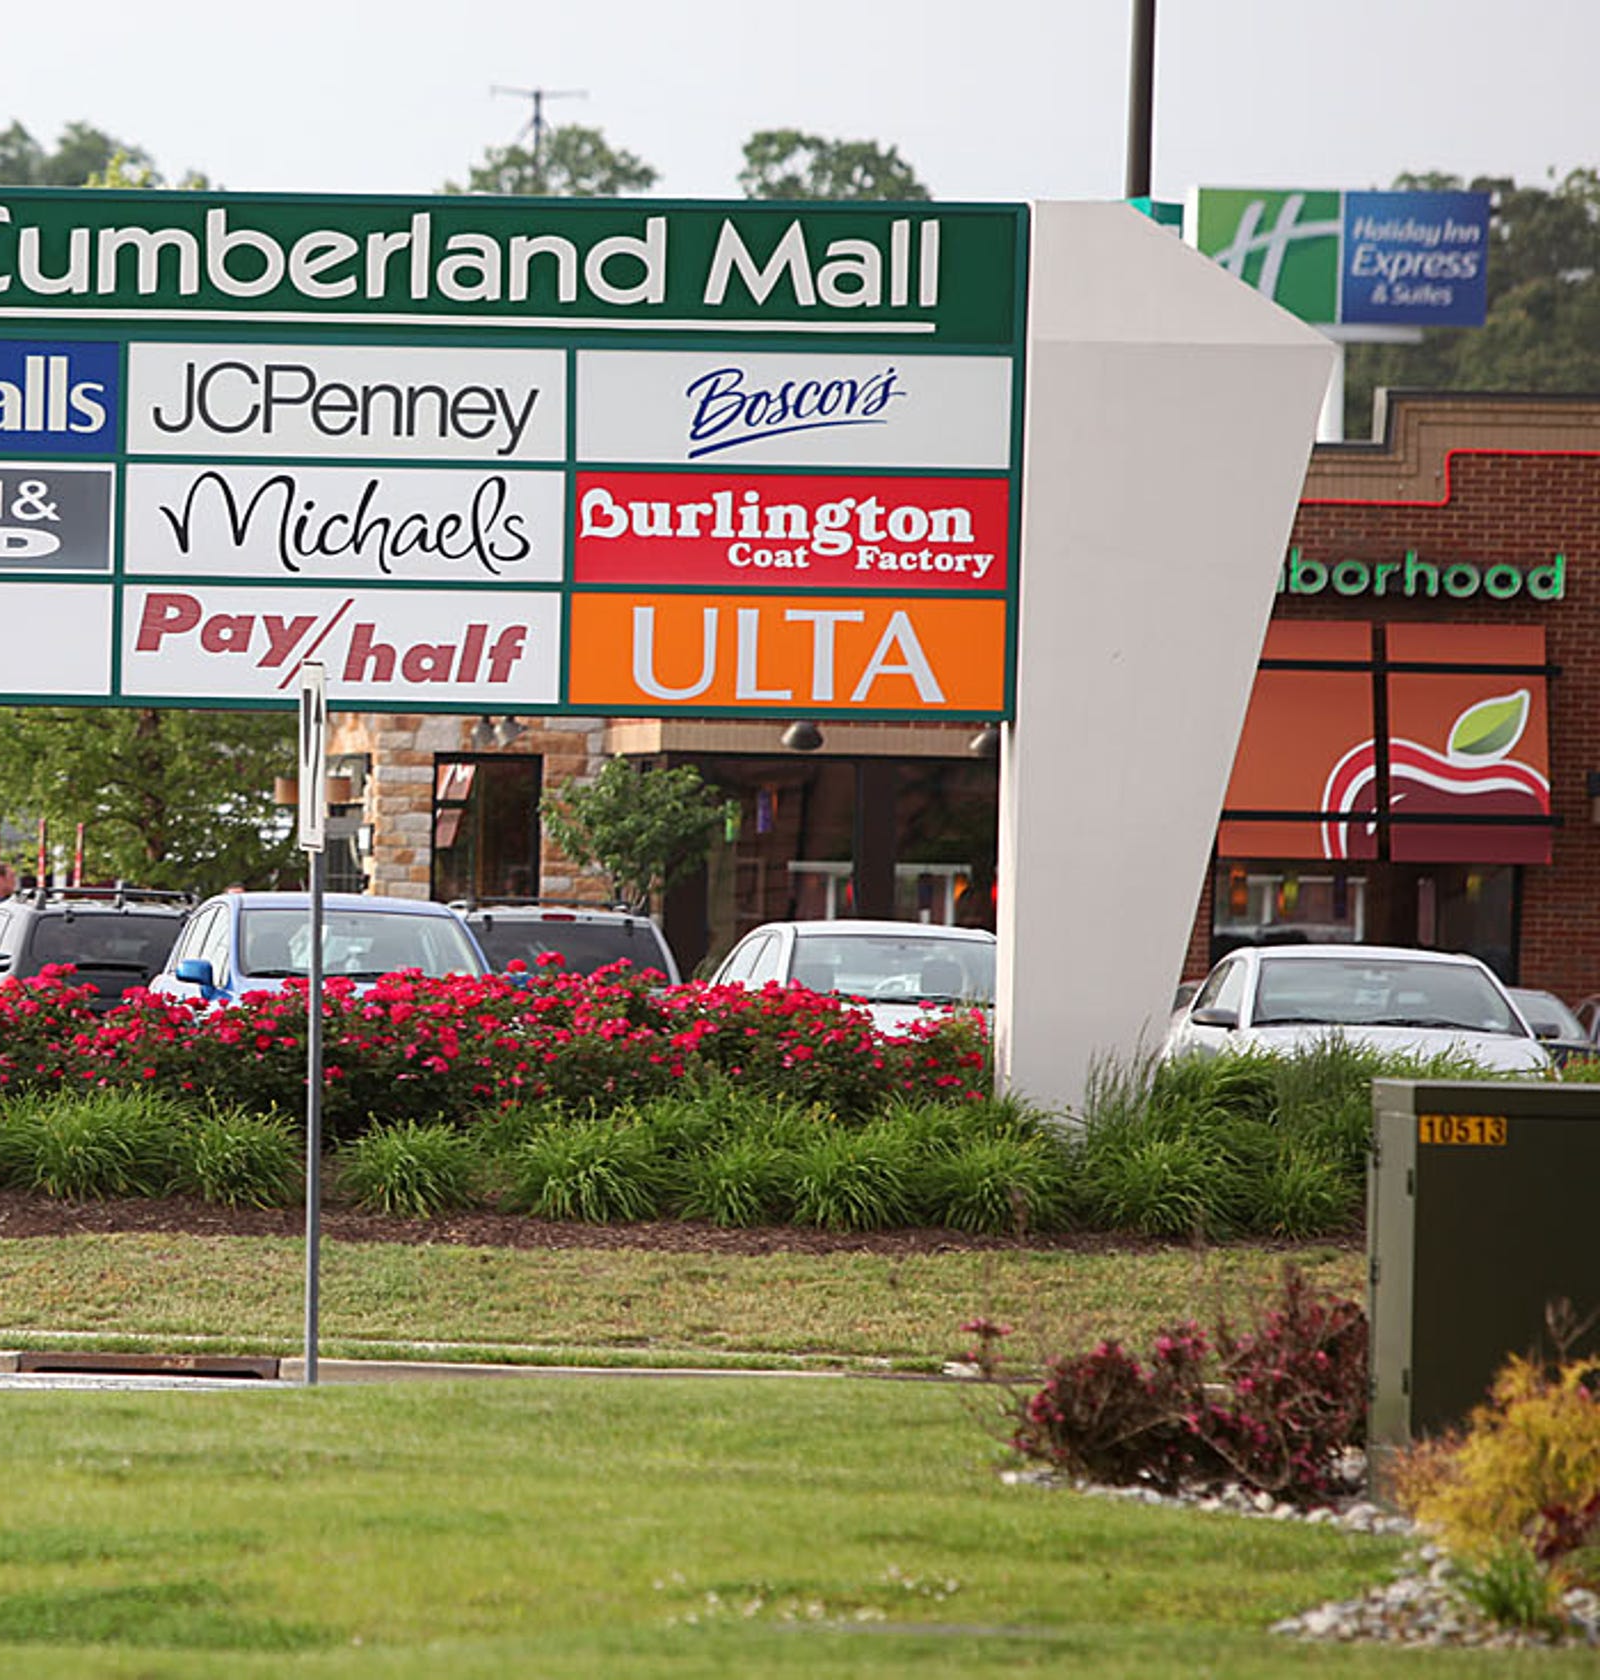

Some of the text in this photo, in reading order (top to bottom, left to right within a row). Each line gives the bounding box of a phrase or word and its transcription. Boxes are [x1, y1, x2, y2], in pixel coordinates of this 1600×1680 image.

[1353, 217, 1481, 246] Holiday Inn
[703, 218, 940, 308] Mall
[1351, 243, 1480, 283] Express
[1391, 284, 1453, 306] Suites
[152, 361, 540, 456] JCPenney
[10, 480, 61, 521] &
[159, 471, 531, 574] Michaels
[580, 487, 974, 556] Burlington
[727, 542, 995, 579] Coat Factory
[1276, 547, 1565, 600] borhood
[632, 606, 947, 703] ULTA
[1426, 1117, 1506, 1143] 10513
